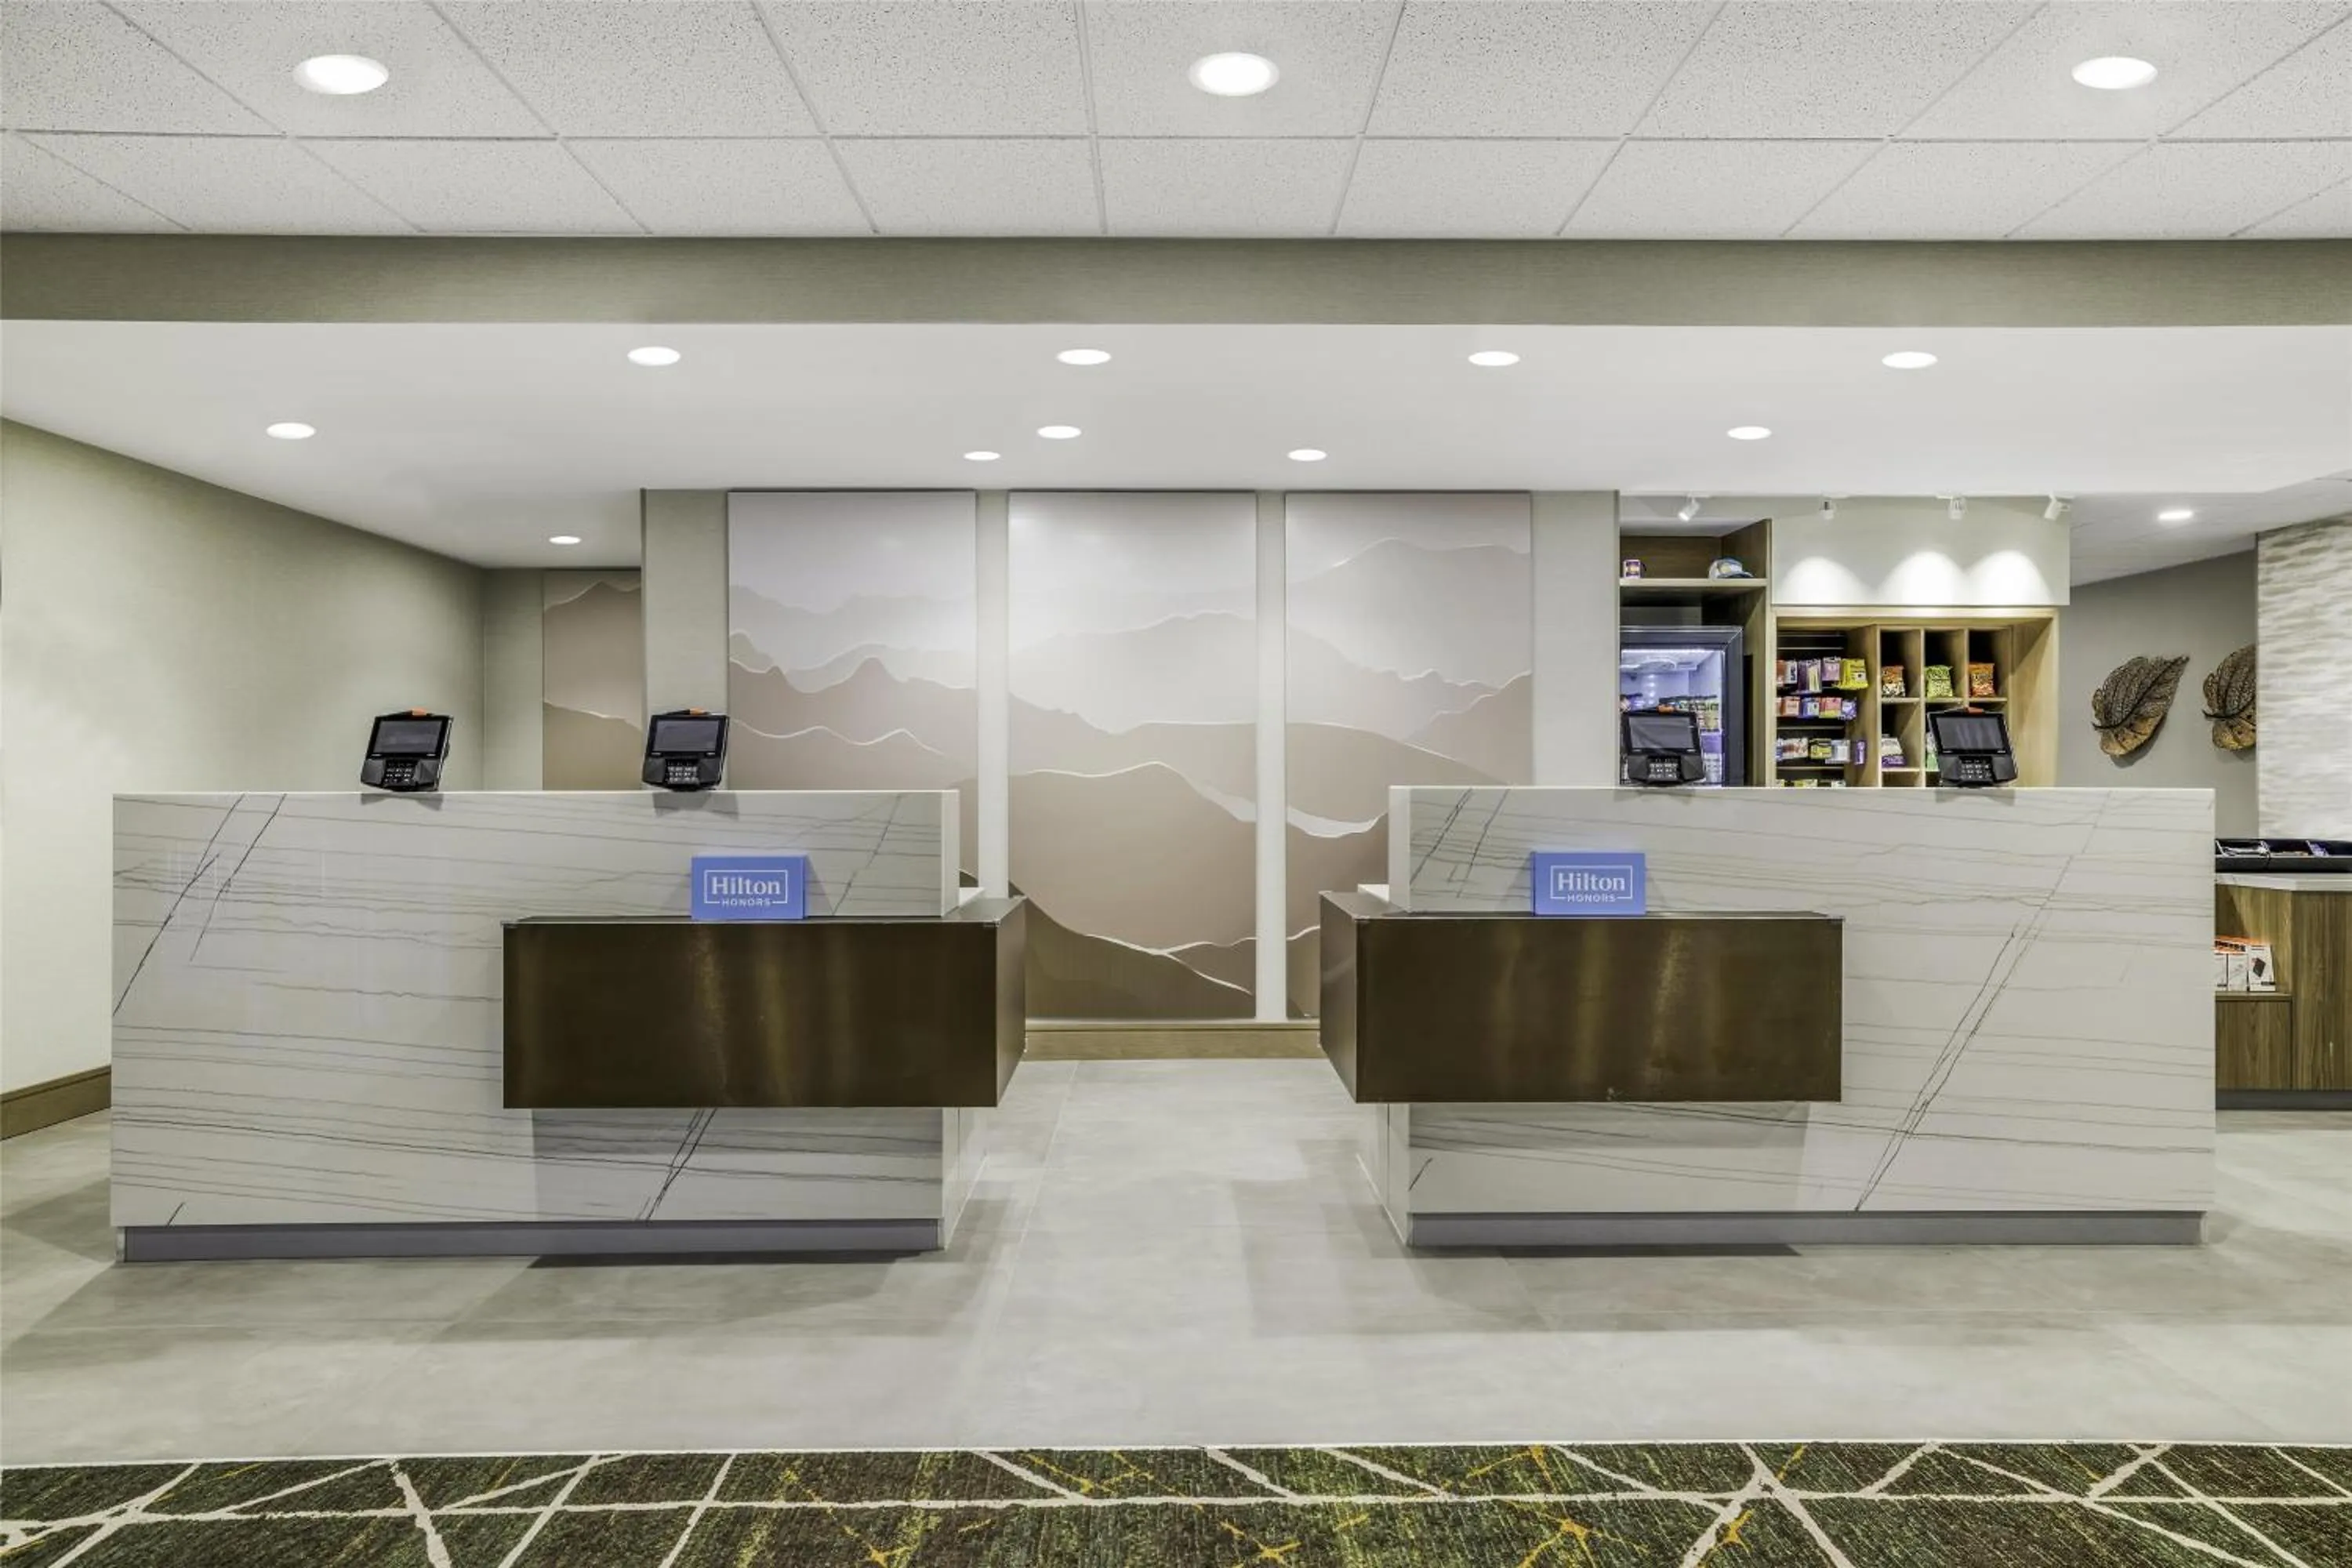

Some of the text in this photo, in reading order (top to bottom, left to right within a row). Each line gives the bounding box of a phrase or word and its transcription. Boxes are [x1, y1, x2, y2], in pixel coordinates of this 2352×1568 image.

[711, 876, 781, 895] Hilton
[1558, 872, 1626, 891] Hilton
[721, 898, 771, 907] HONORS
[1567, 893, 1616, 902] HONORS
